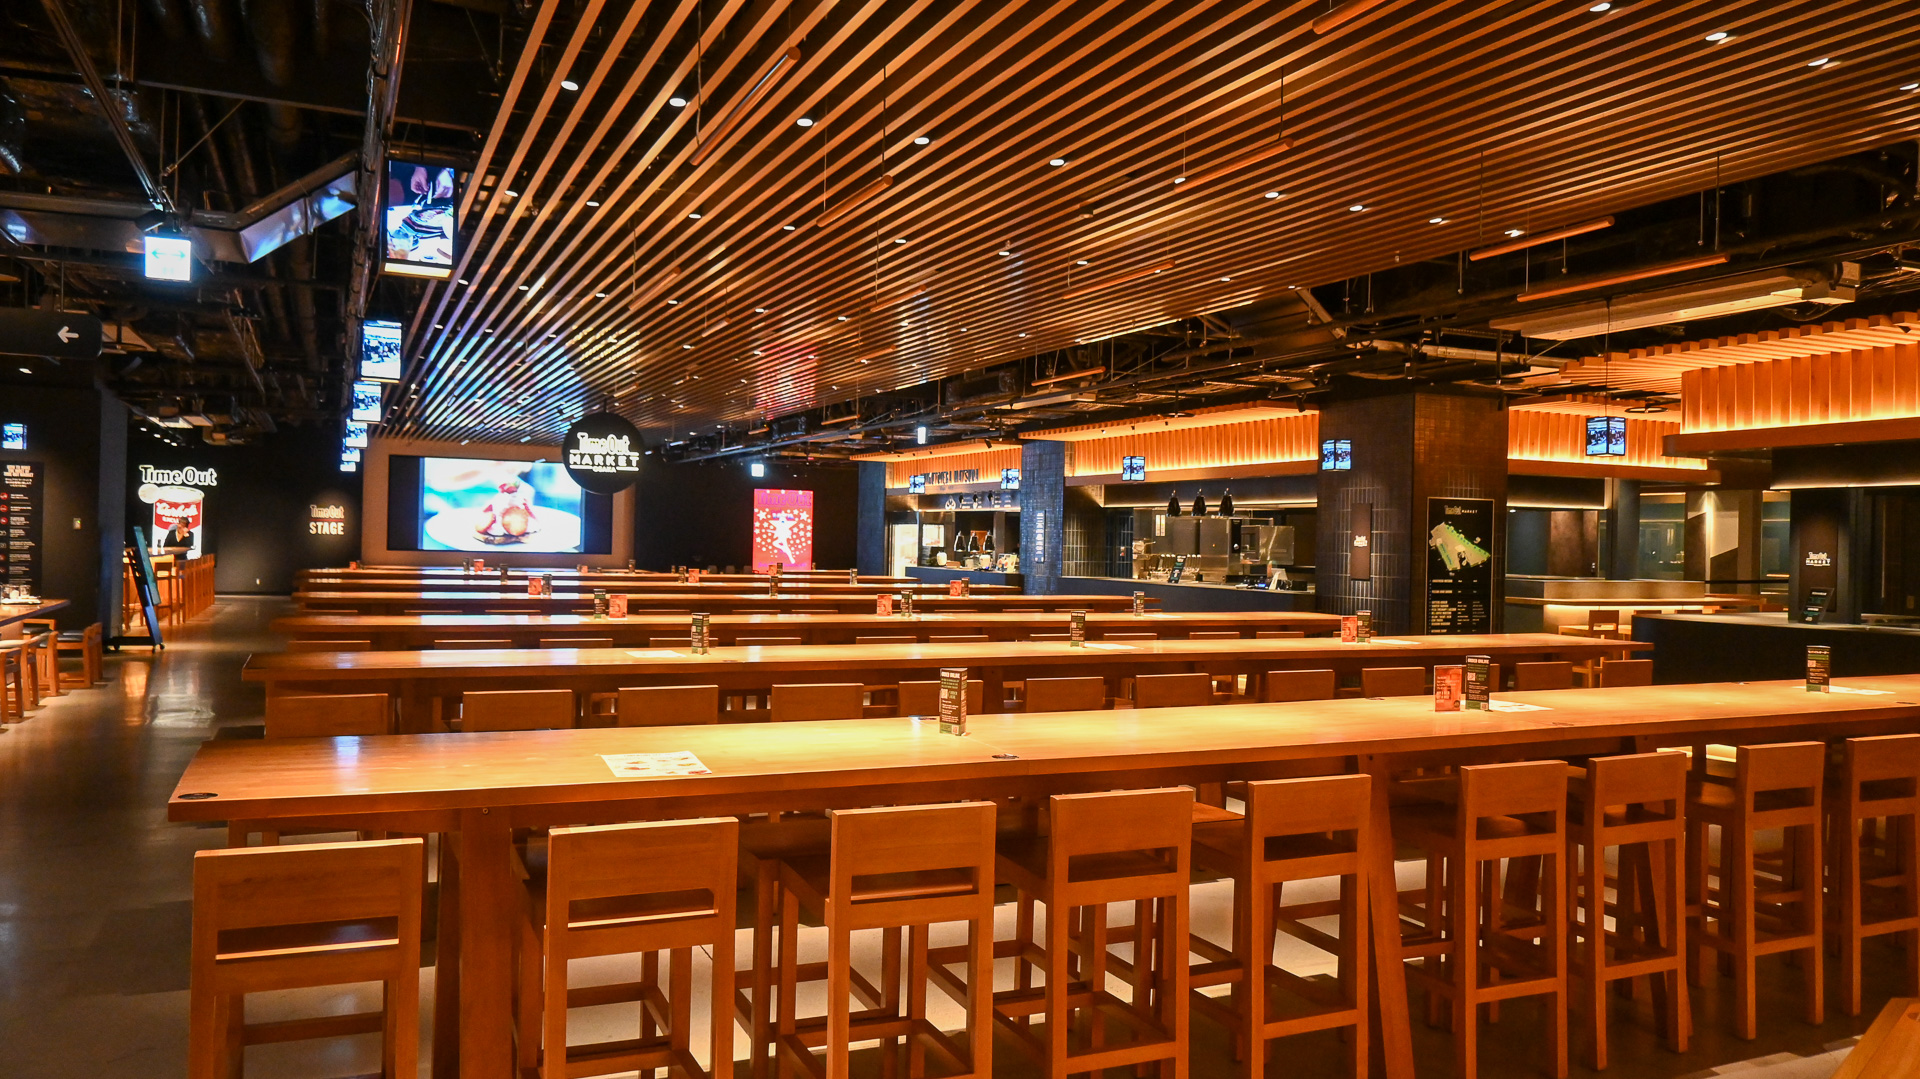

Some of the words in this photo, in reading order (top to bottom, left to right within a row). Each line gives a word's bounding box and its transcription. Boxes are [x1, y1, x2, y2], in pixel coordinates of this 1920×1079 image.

[569, 453, 639, 467] MARKET
[139, 465, 182, 484] Time
[183, 466, 217, 486] Out
[309, 521, 344, 535] STAGE
